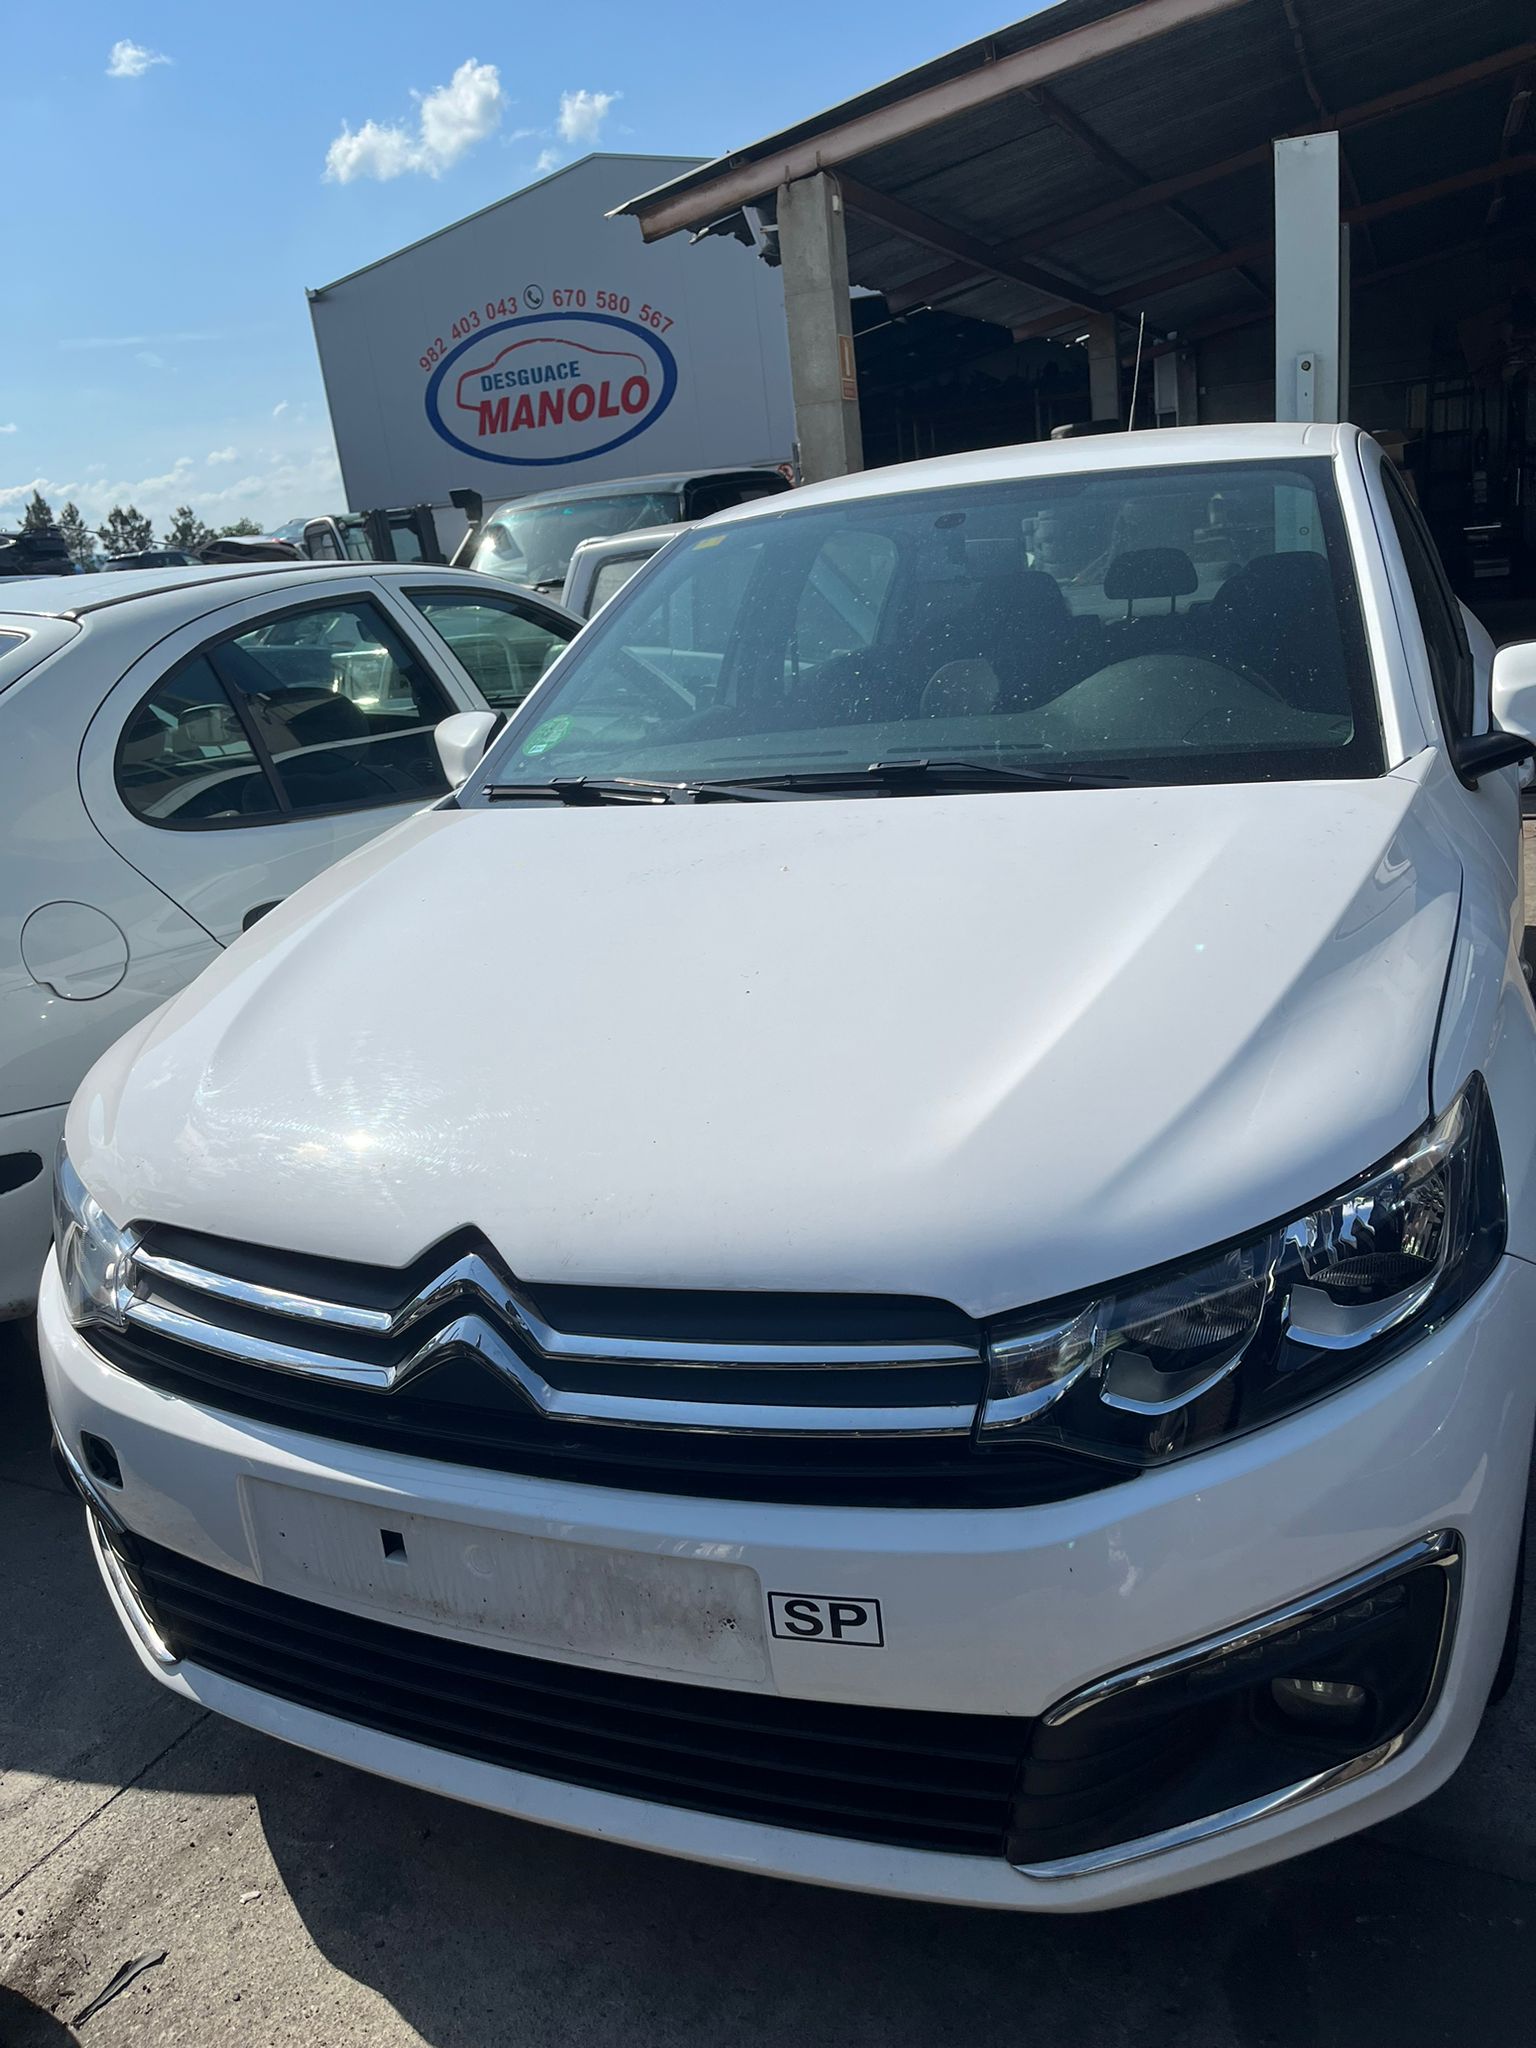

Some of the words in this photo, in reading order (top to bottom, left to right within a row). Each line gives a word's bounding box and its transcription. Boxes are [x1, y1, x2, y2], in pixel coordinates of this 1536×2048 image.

[419, 337, 448, 372] 982
[451, 310, 481, 341] 403
[485, 297, 518, 320] 043
[552, 289, 586, 307] 670
[596, 290, 630, 314] 580
[639, 304, 674, 334] 567
[480, 360, 581, 392] DESGUACE
[478, 375, 650, 436] MANOLO
[784, 1599, 867, 1639] SP
